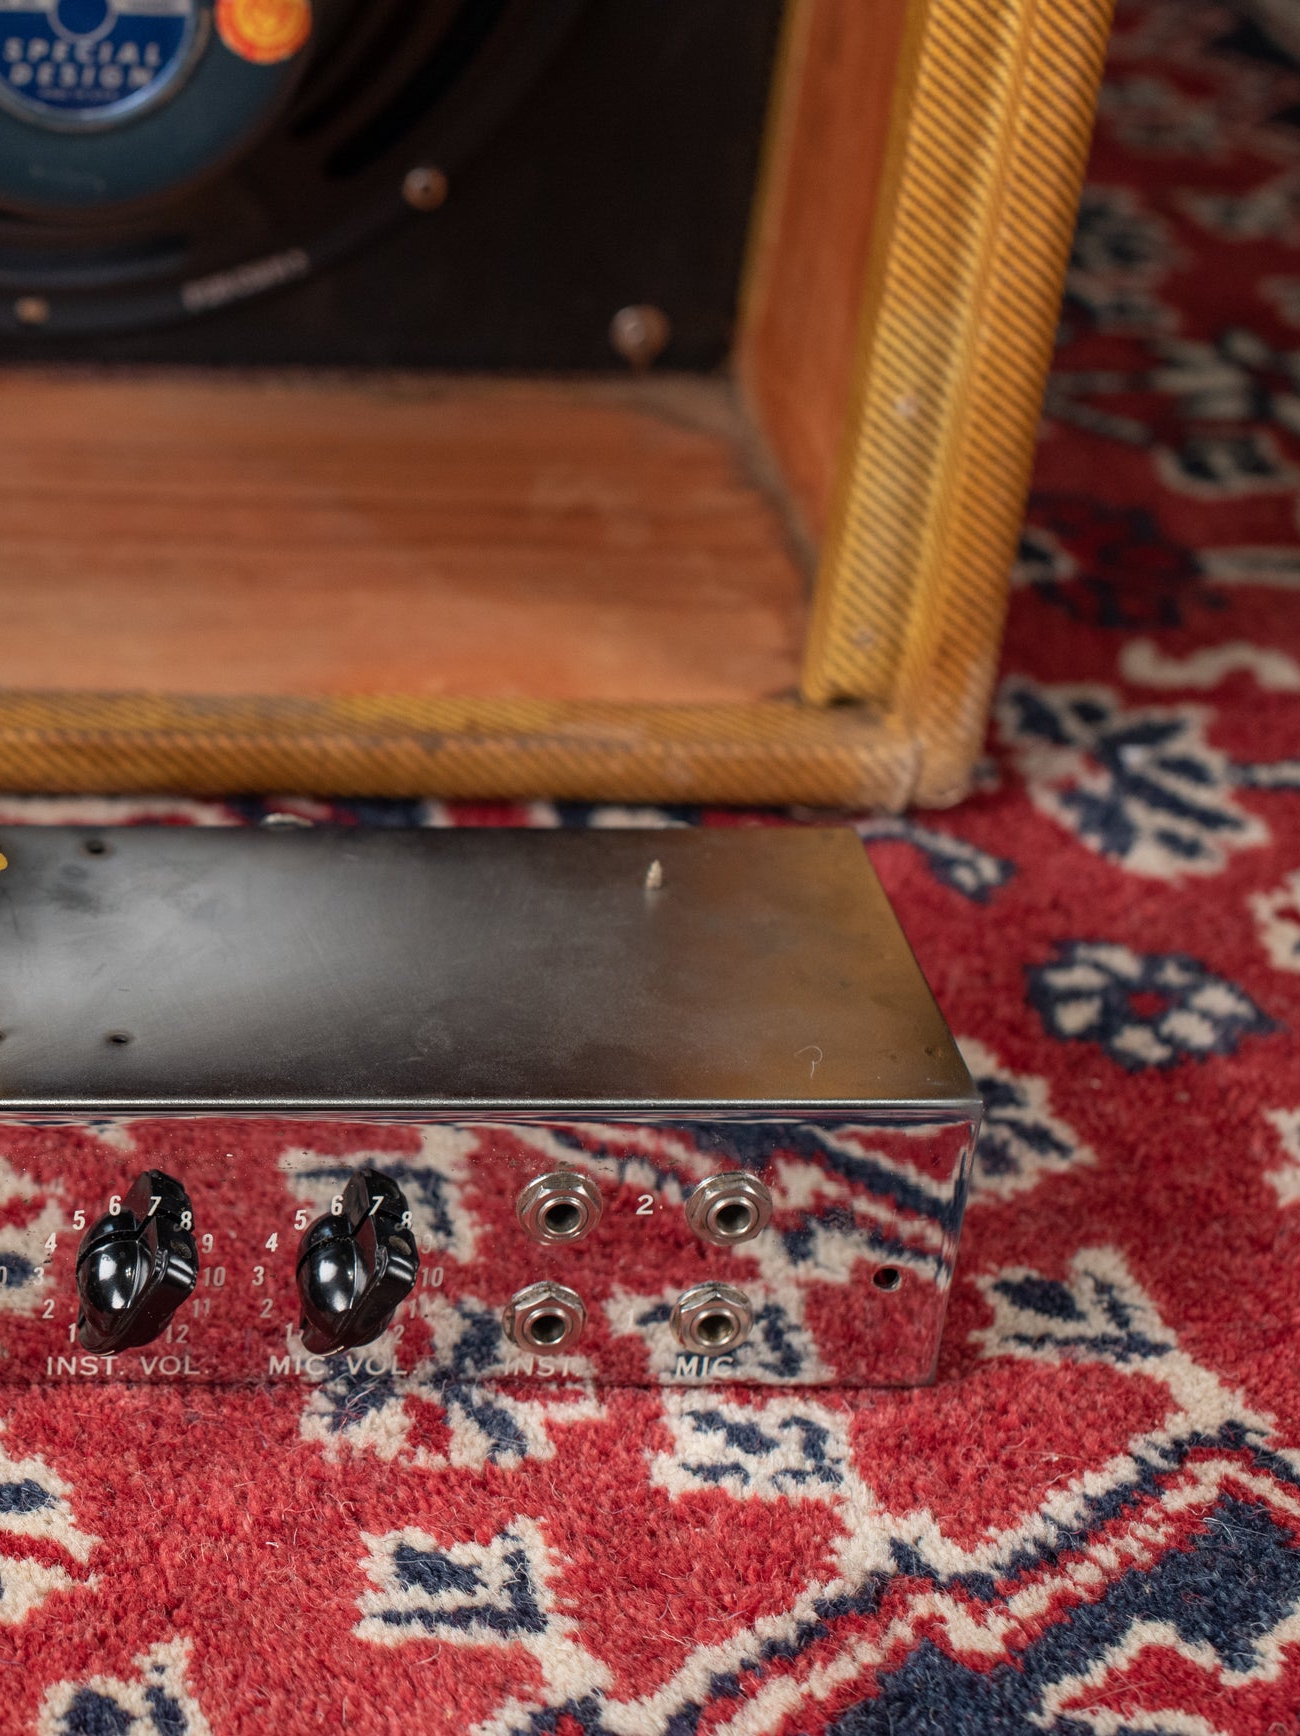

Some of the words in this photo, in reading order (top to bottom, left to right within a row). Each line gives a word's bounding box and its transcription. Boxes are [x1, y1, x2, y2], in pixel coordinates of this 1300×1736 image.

[3, 37, 160, 67] SPECIAL
[8, 62, 152, 89] DESIGN
[109, 1195, 121, 1215] 6
[148, 1196, 162, 1216] 7
[331, 1195, 343, 1215] 6
[368, 1196, 384, 1216] 7
[636, 1194, 654, 1215] 2
[72, 1210, 86, 1230] 5
[180, 1211, 192, 1231] 8
[294, 1210, 307, 1230] 5
[401, 1211, 413, 1230] 8
[45, 1232, 57, 1253] 4
[202, 1234, 214, 1253] 9
[265, 1233, 278, 1253] 4
[420, 1233, 433, 1254] 9
[34, 1267, 44, 1286] 3
[204, 1266, 226, 1287] 10
[252, 1265, 265, 1286] 3
[422, 1266, 444, 1287] 10
[42, 1299, 55, 1319] 2
[193, 1299, 211, 1318] 11
[260, 1298, 273, 1318] 2
[68, 1323, 77, 1343] 1
[166, 1324, 189, 1344] 12
[285, 1322, 294, 1342] 1
[46, 1356, 124, 1376] INST.
[269, 1355, 334, 1375] MIC.
